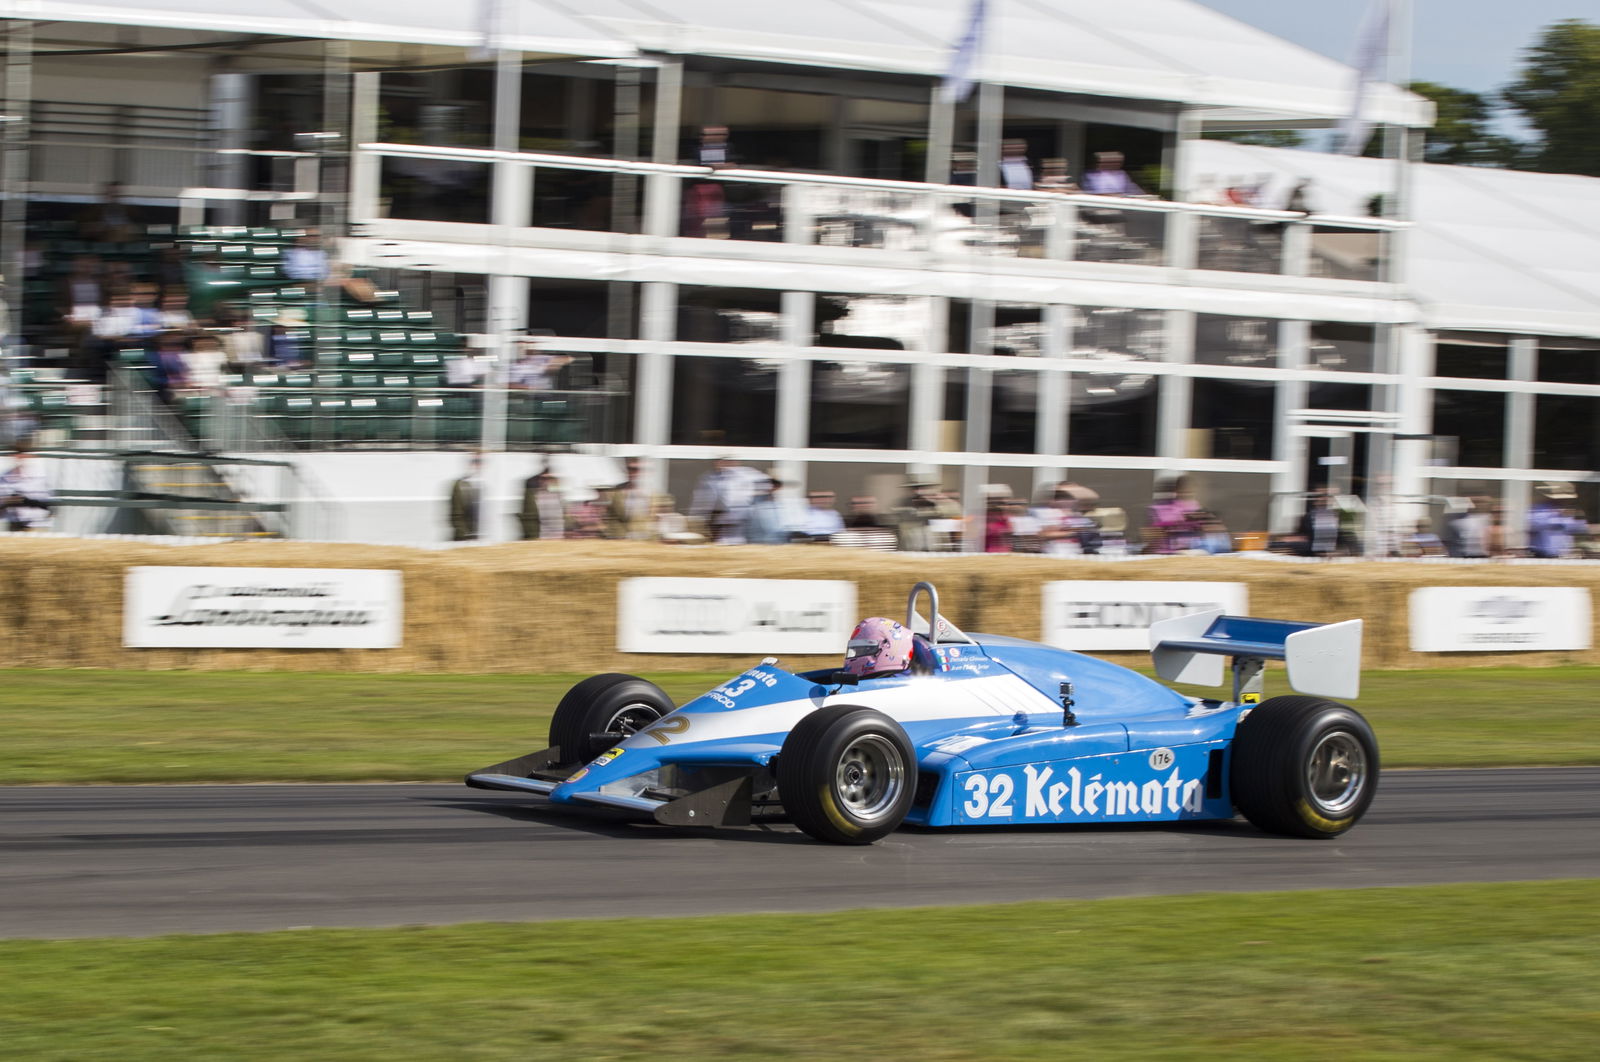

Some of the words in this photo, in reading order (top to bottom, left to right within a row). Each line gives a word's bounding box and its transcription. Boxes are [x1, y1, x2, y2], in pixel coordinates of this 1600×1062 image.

[1153, 753, 1171, 766] 176
[964, 773, 1014, 819] 32
[1023, 764, 1203, 817] Kelémata
